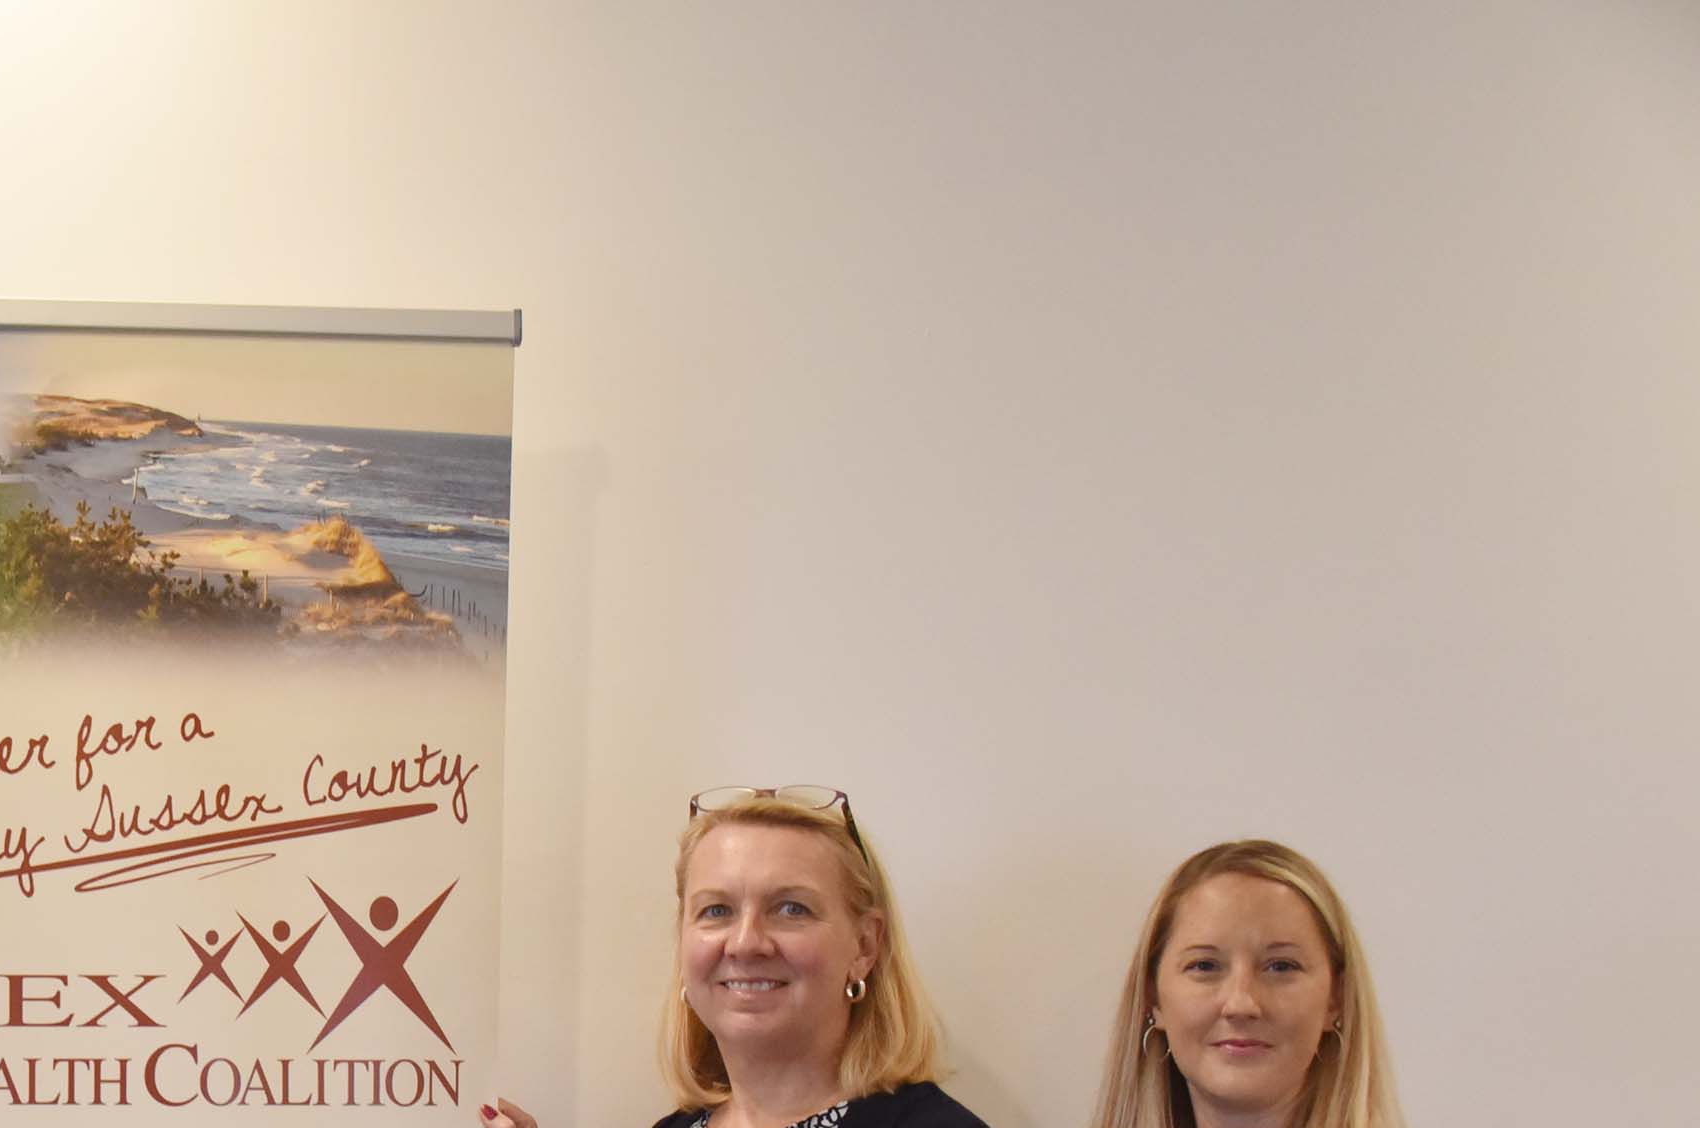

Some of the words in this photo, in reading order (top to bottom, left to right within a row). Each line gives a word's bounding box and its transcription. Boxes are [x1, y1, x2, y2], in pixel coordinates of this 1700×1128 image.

[75, 714, 163, 791] for
[180, 712, 215, 742] a
[64, 784, 284, 853] Sussex
[302, 744, 480, 824] County
[144, 1039, 464, 1108] COALITION
